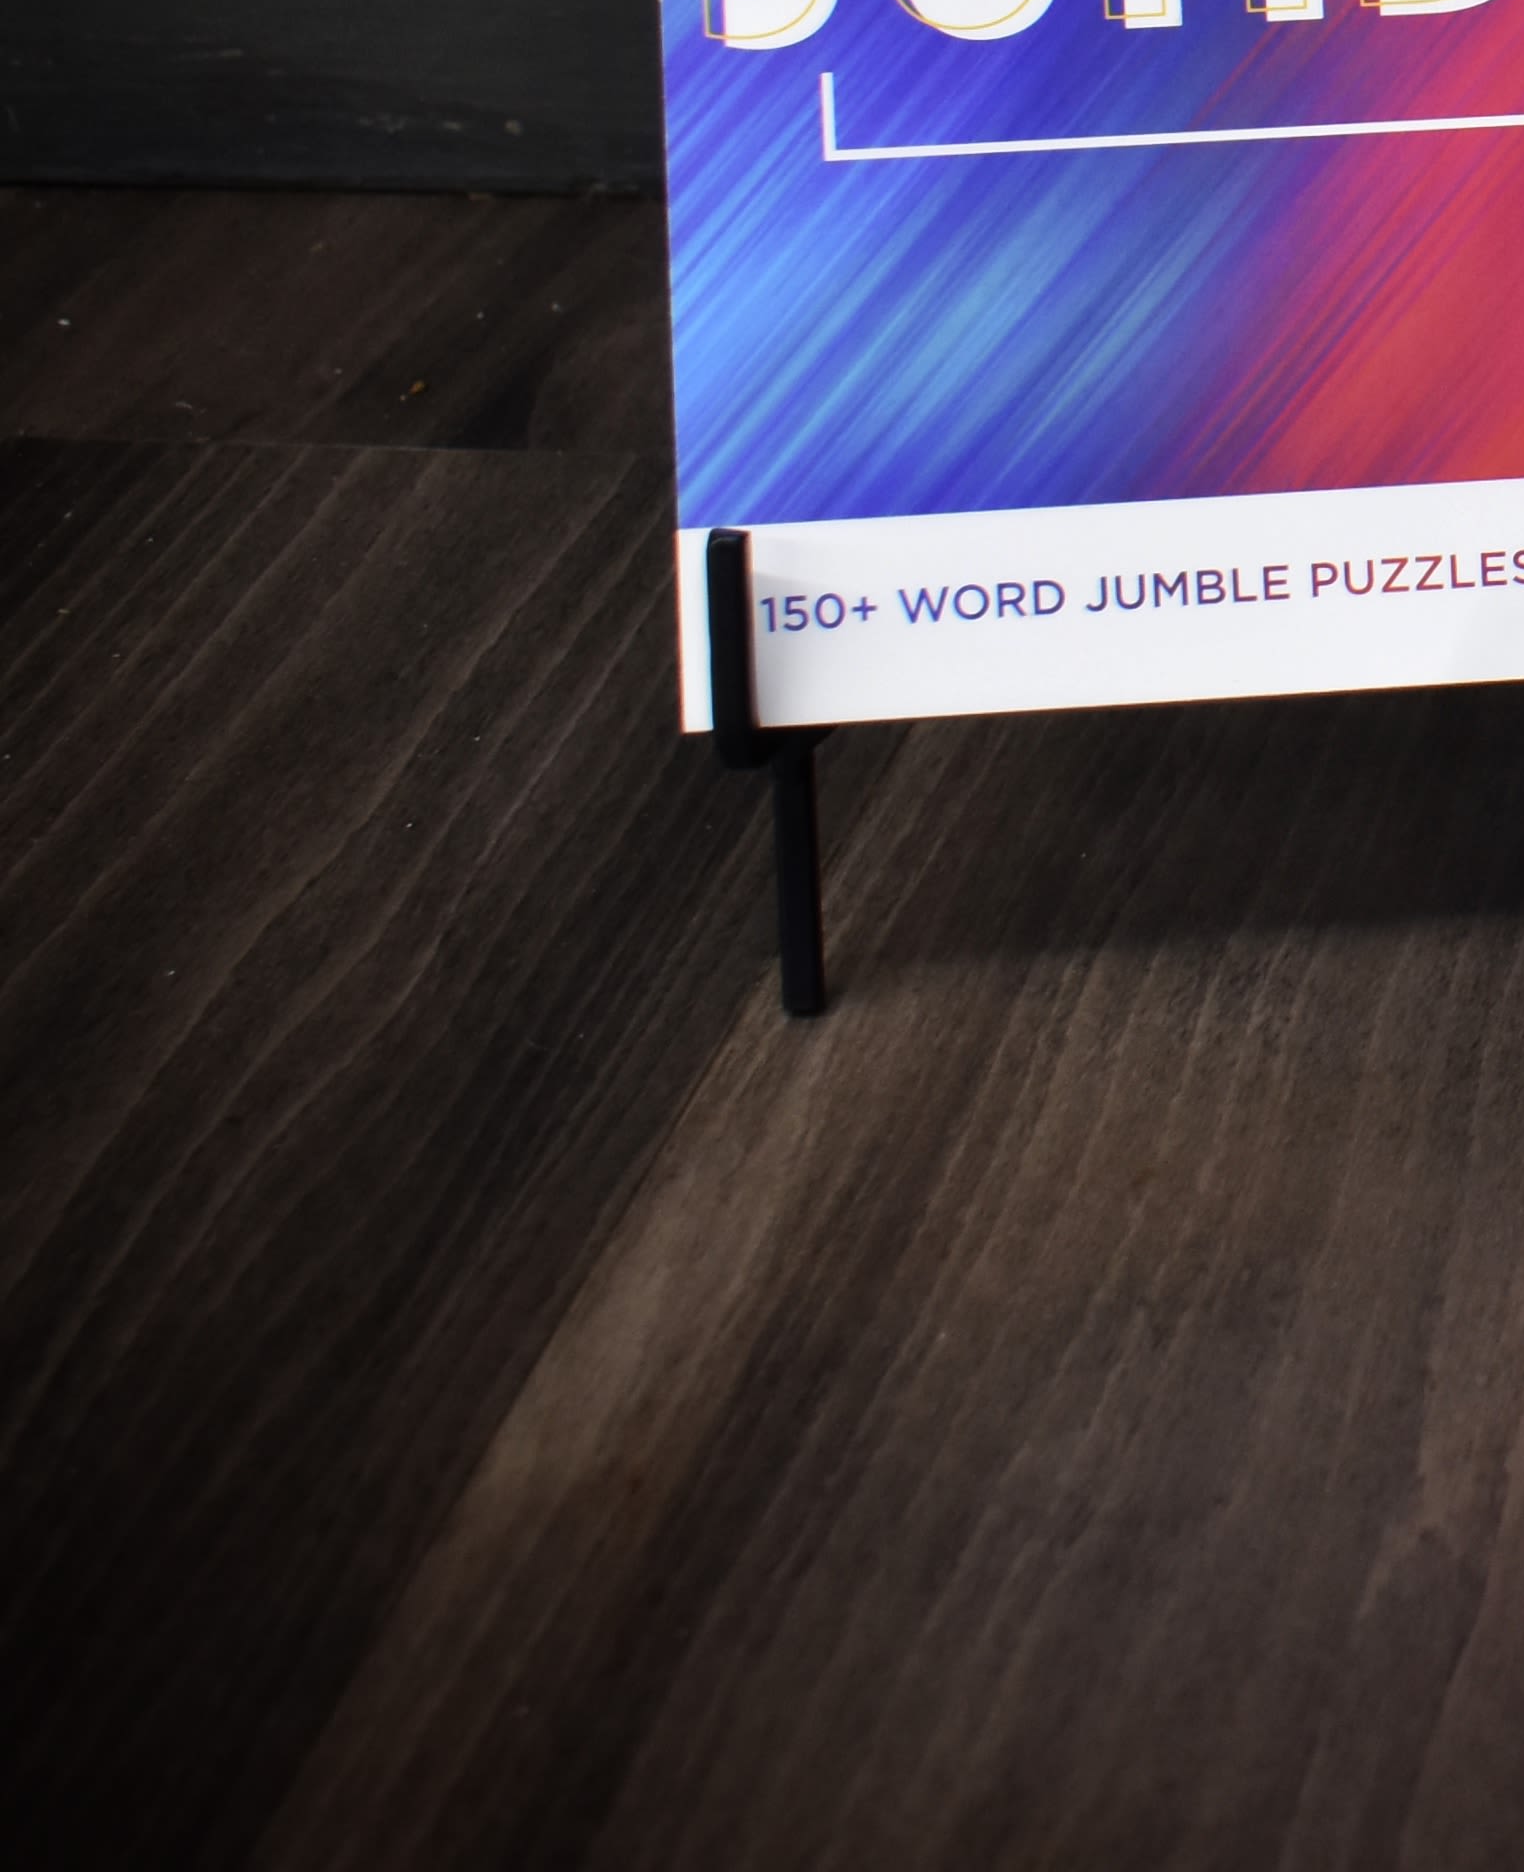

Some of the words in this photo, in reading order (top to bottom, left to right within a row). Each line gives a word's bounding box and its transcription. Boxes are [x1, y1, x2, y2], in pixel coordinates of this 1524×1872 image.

[758, 592, 878, 634] 150+
[896, 577, 1067, 626] WORD
[1084, 563, 1292, 614] JUMBLE
